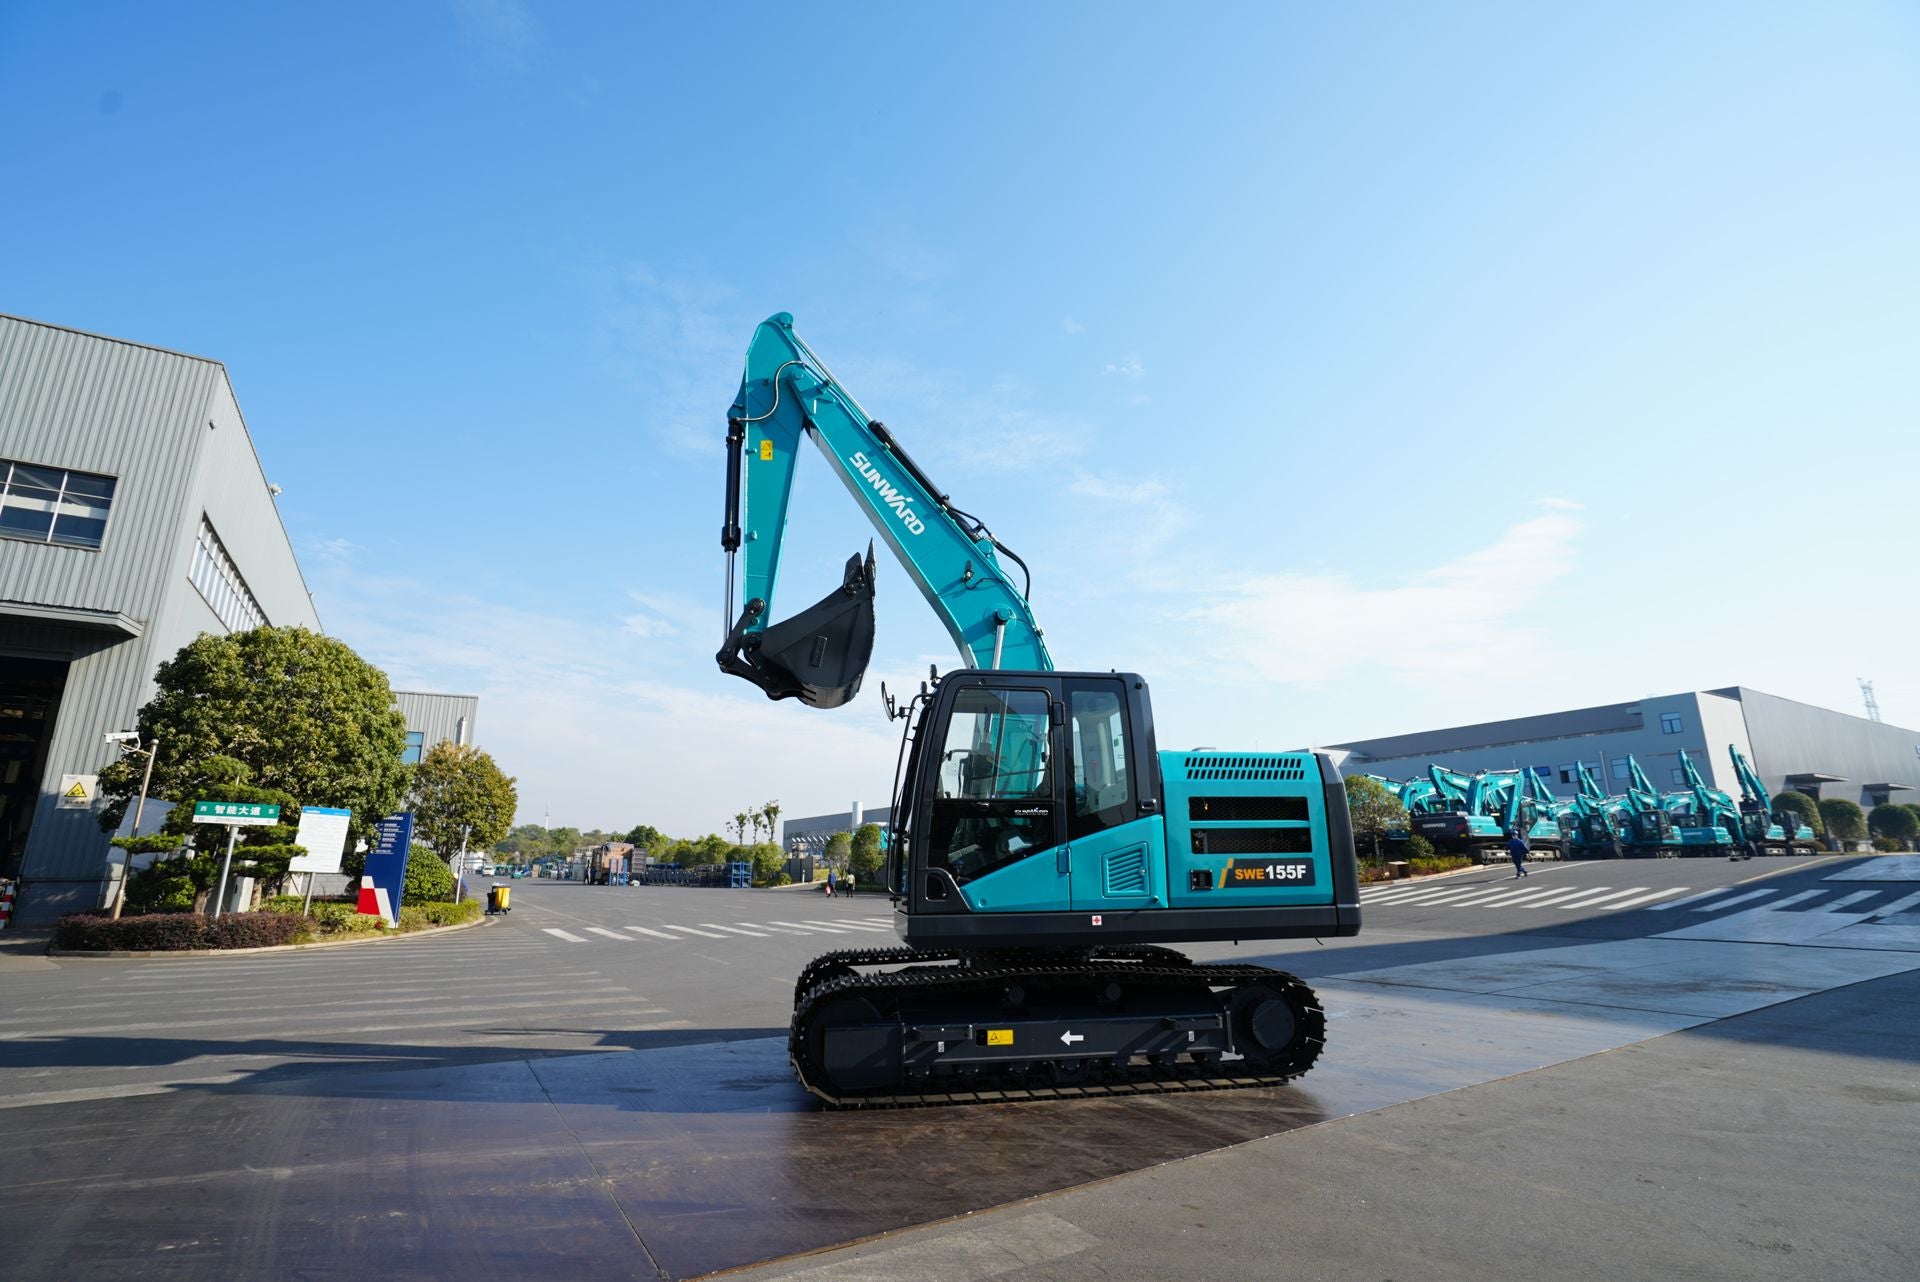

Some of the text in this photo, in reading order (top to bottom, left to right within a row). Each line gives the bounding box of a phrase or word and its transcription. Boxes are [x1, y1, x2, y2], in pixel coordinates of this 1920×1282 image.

[849, 451, 926, 536] SUNWARD
[214, 804, 262, 816] 智能大道
